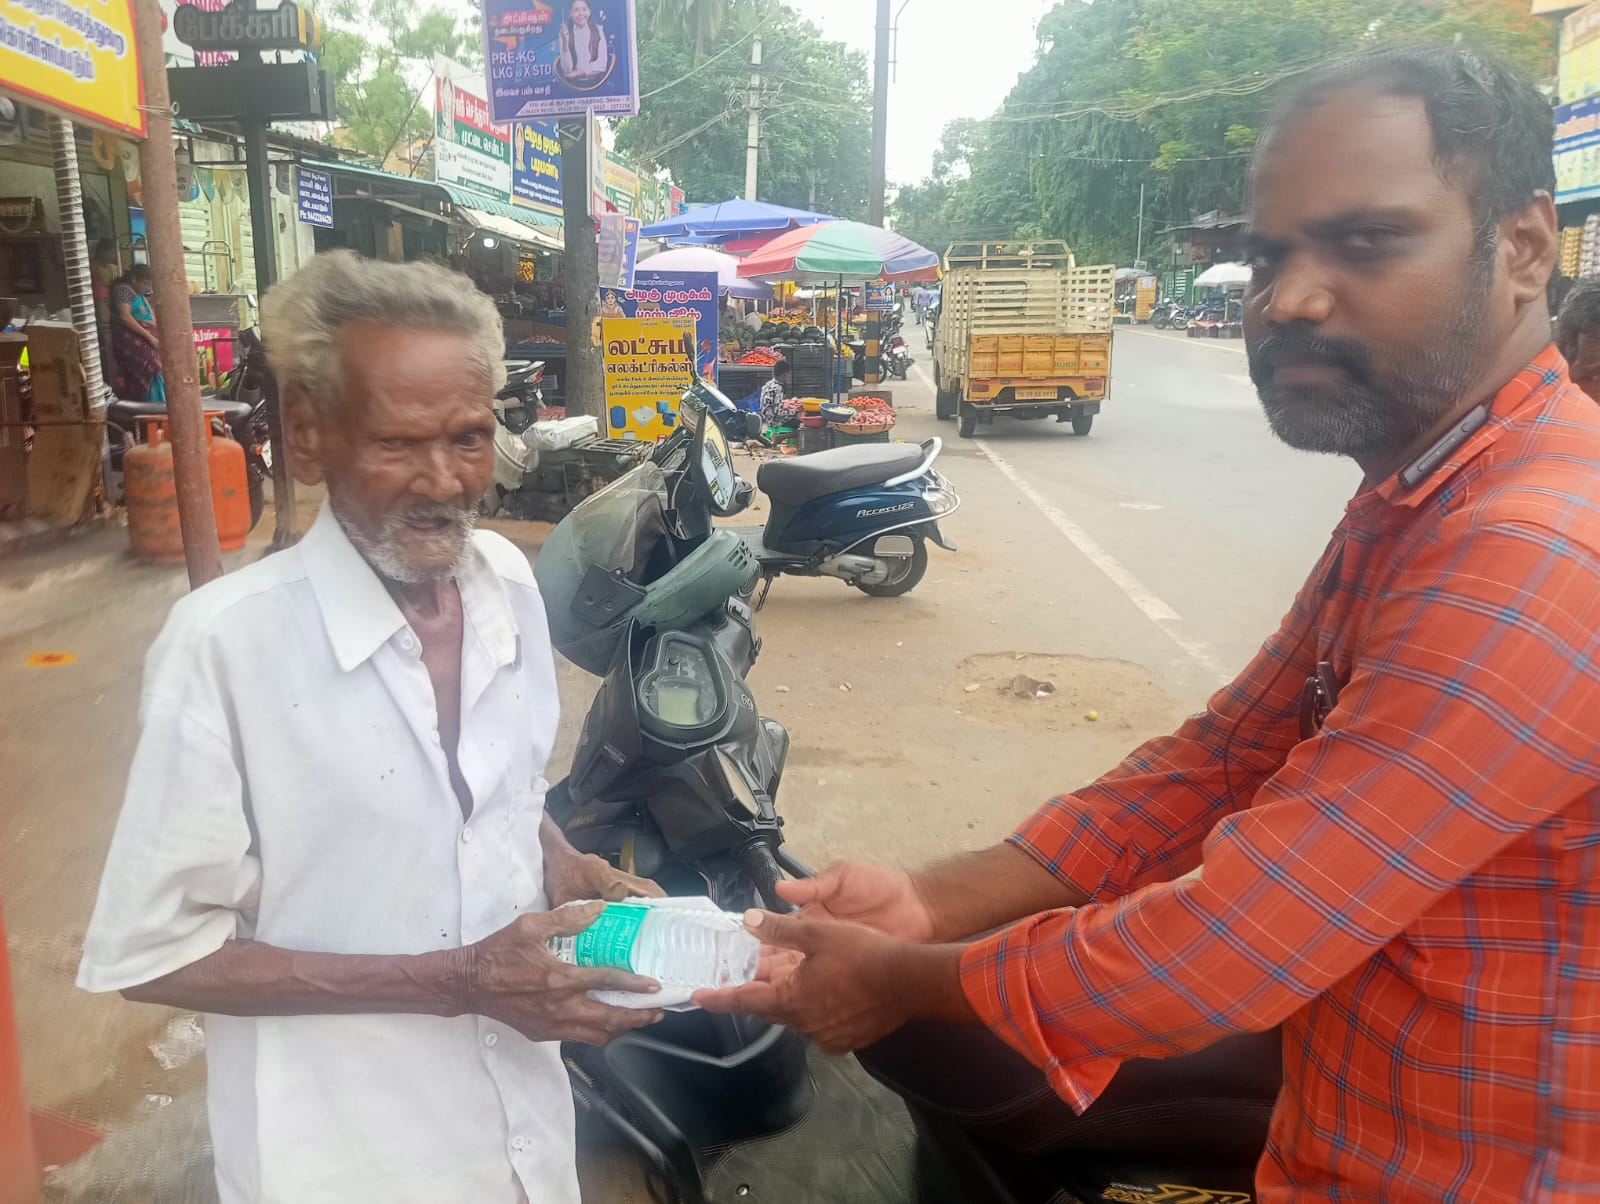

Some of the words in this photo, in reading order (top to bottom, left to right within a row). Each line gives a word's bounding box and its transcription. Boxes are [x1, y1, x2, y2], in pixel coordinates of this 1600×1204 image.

[492, 50, 536, 64] PRE-KG
[493, 66, 513, 79] LKG
[533, 64, 552, 76] STD
[625, 288, 661, 302] அழகு
[663, 287, 712, 303] முருகன்
[607, 358, 692, 374] எலக்ட்ரிகல்ஸ்
